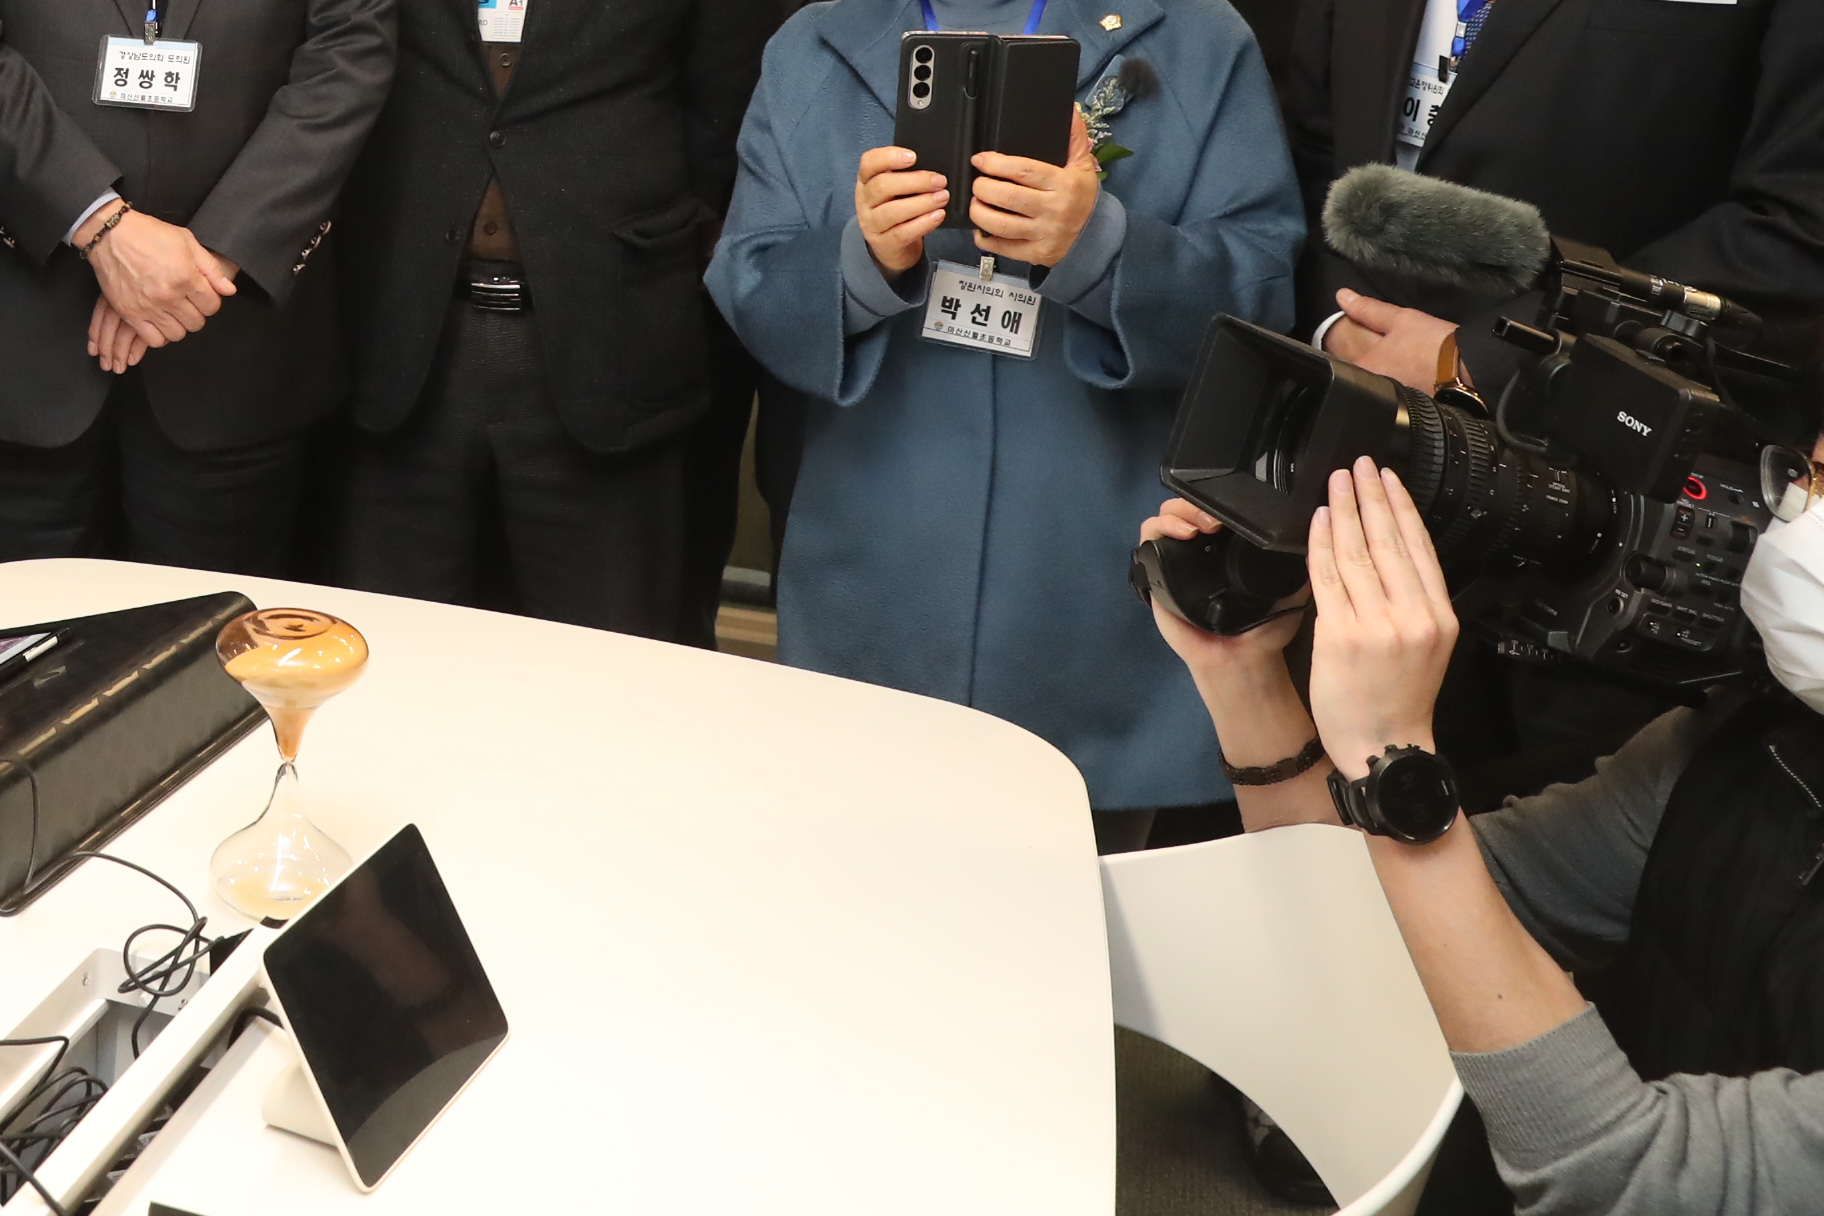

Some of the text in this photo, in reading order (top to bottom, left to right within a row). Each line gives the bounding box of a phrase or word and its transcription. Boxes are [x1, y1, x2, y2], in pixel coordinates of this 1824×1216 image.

[119, 50, 190, 64] 경상남도의회 도의원
[958, 280, 1037, 306] 창원시의회 시의원
[1616, 410, 1653, 437] SONY
